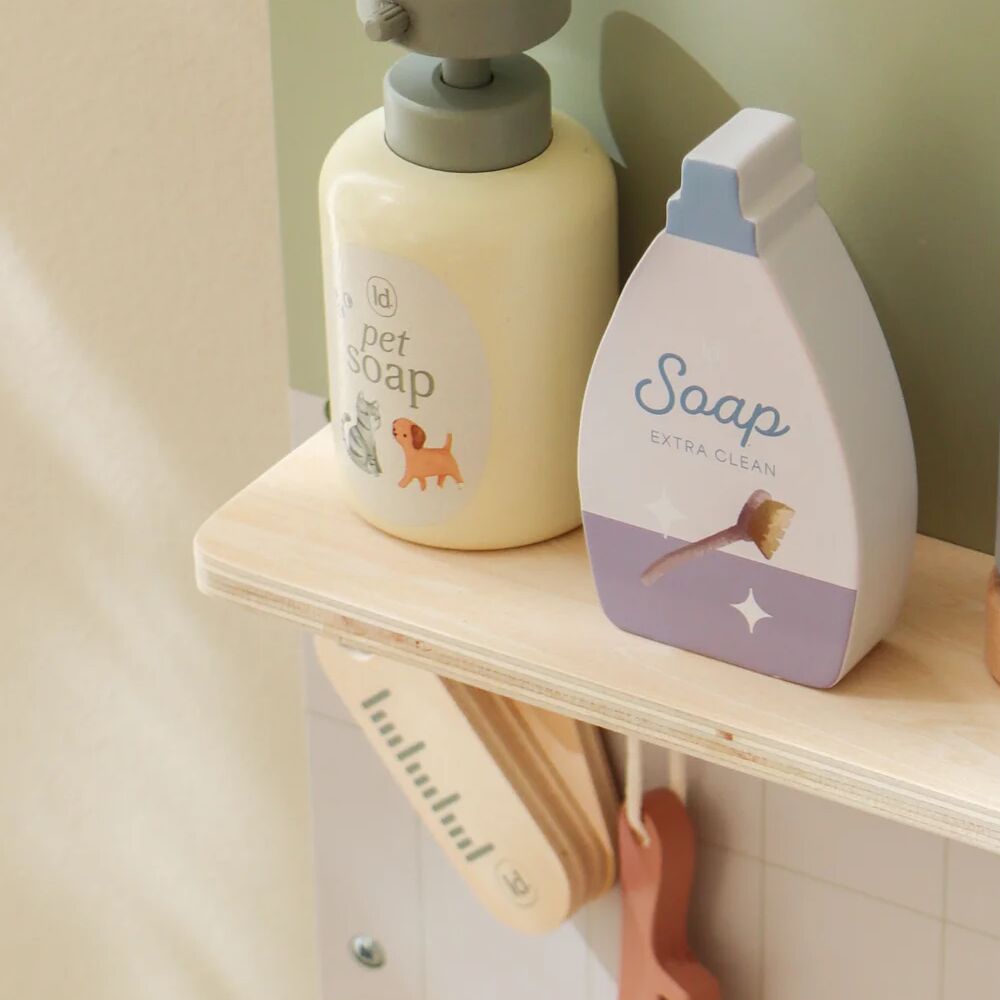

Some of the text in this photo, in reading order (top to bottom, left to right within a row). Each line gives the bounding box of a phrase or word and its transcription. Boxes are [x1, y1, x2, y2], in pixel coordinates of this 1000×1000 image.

[361, 323, 411, 357] pet
[347, 344, 435, 410] soap
[635, 352, 791, 448] Soap
[650, 429, 776, 477] EXTRA CLEAN
